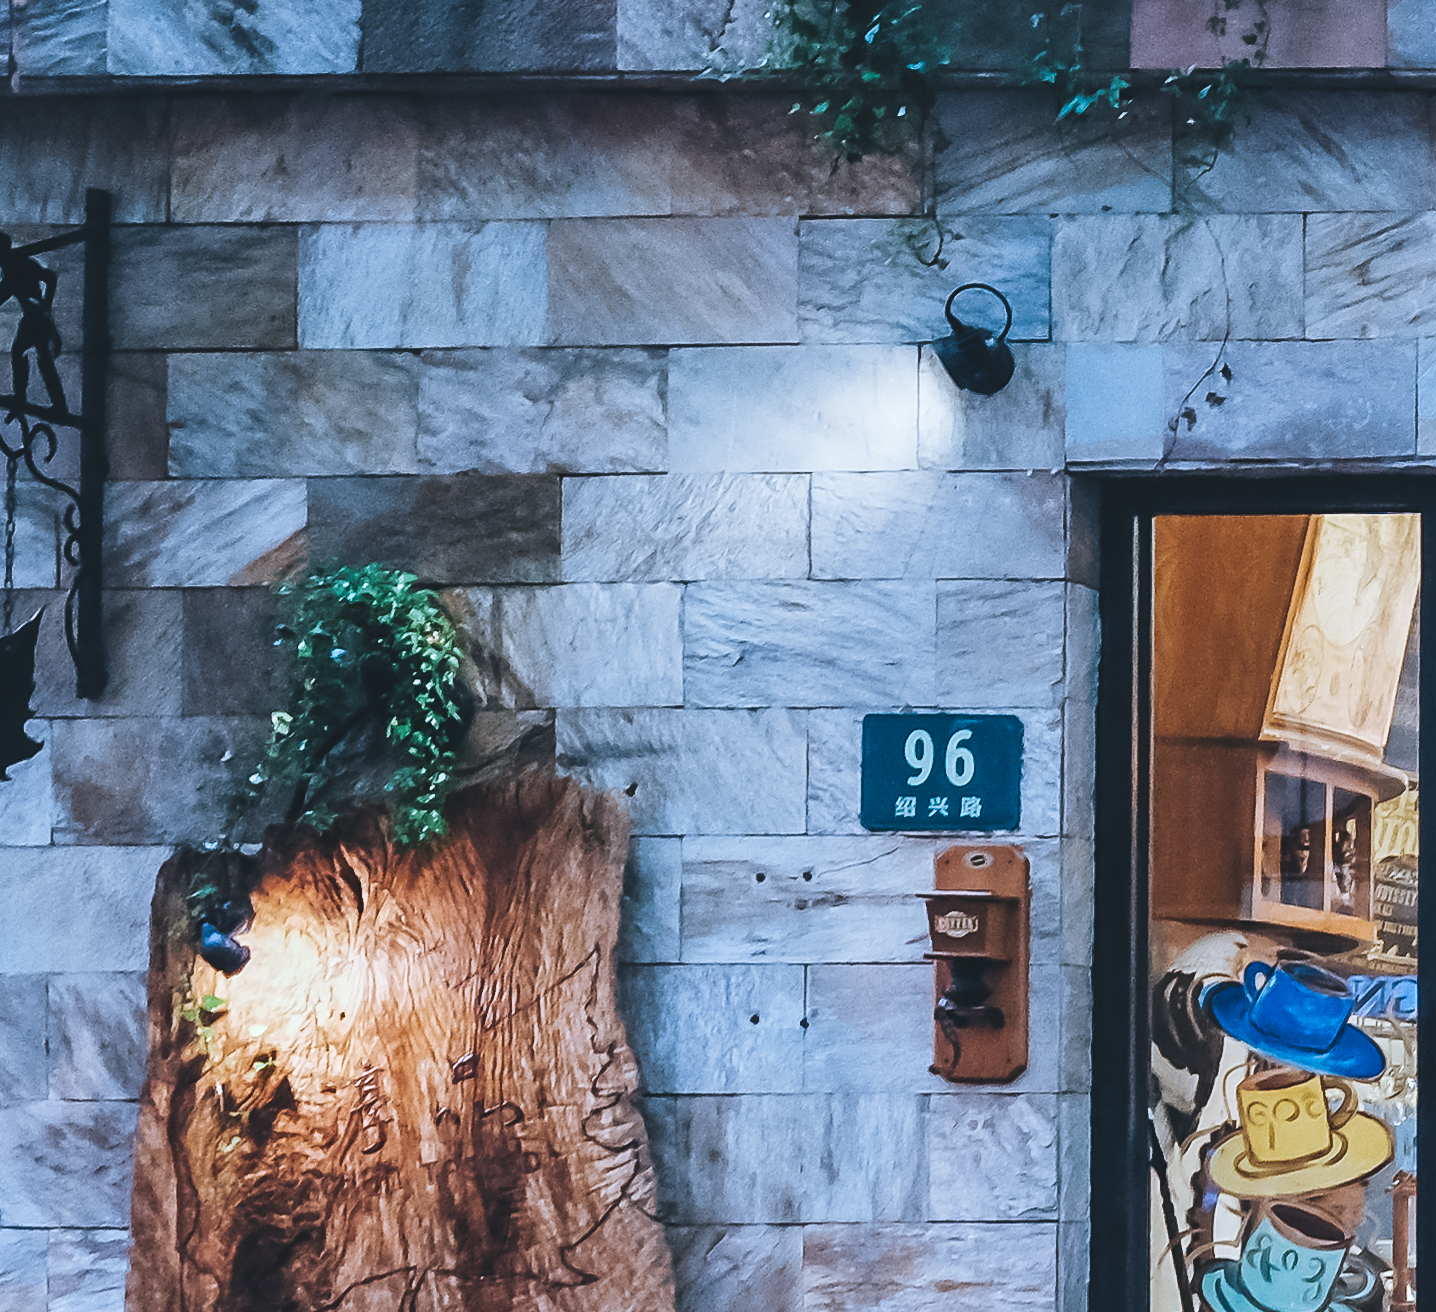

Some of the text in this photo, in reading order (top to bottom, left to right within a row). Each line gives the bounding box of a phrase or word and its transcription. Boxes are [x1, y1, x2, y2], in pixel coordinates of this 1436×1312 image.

[904, 729, 974, 787] 96
[894, 796, 982, 818] 绍兴路
